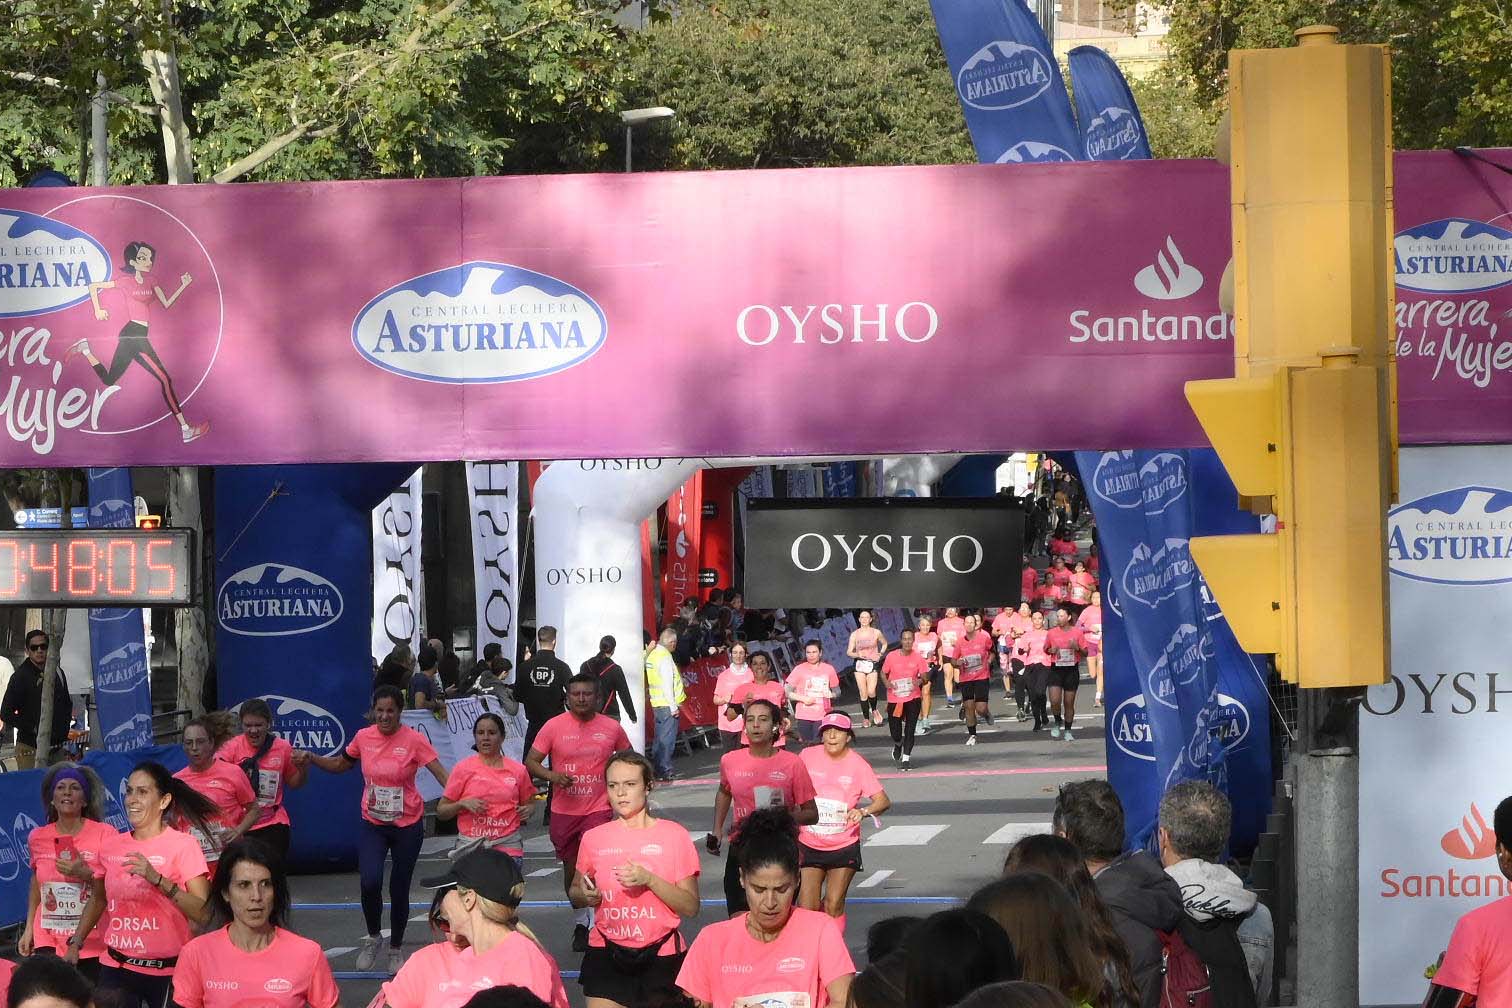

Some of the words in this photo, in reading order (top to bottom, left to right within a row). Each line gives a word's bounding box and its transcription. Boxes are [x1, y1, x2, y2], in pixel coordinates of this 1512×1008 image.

[14, 245, 87, 257] LECHERA
[1465, 243, 1512, 252] LECHER
[411, 305, 489, 318] CENTRAL
[497, 302, 579, 316] LECHERA
[1394, 299, 1490, 328] arrera
[371, 309, 588, 354] ASTURIANA
[736, 302, 939, 346] OYSHO
[1068, 309, 1236, 343] Santand
[1418, 330, 1437, 357] la
[1432, 324, 1512, 388] Muje
[1415, 520, 1482, 532] CENTRAL
[790, 533, 983, 574] OYSHO
[547, 566, 622, 586] OYSHO
[221, 593, 335, 620] ASTURIANA
[536, 671, 549, 680] BP
[1361, 671, 1512, 716] OYSH
[572, 775, 602, 784] ORSAL
[1381, 868, 1512, 898] Santan
[58, 901, 76, 909] 016
[111, 917, 160, 931] ORSAL
[206, 981, 238, 990] OYSHO
